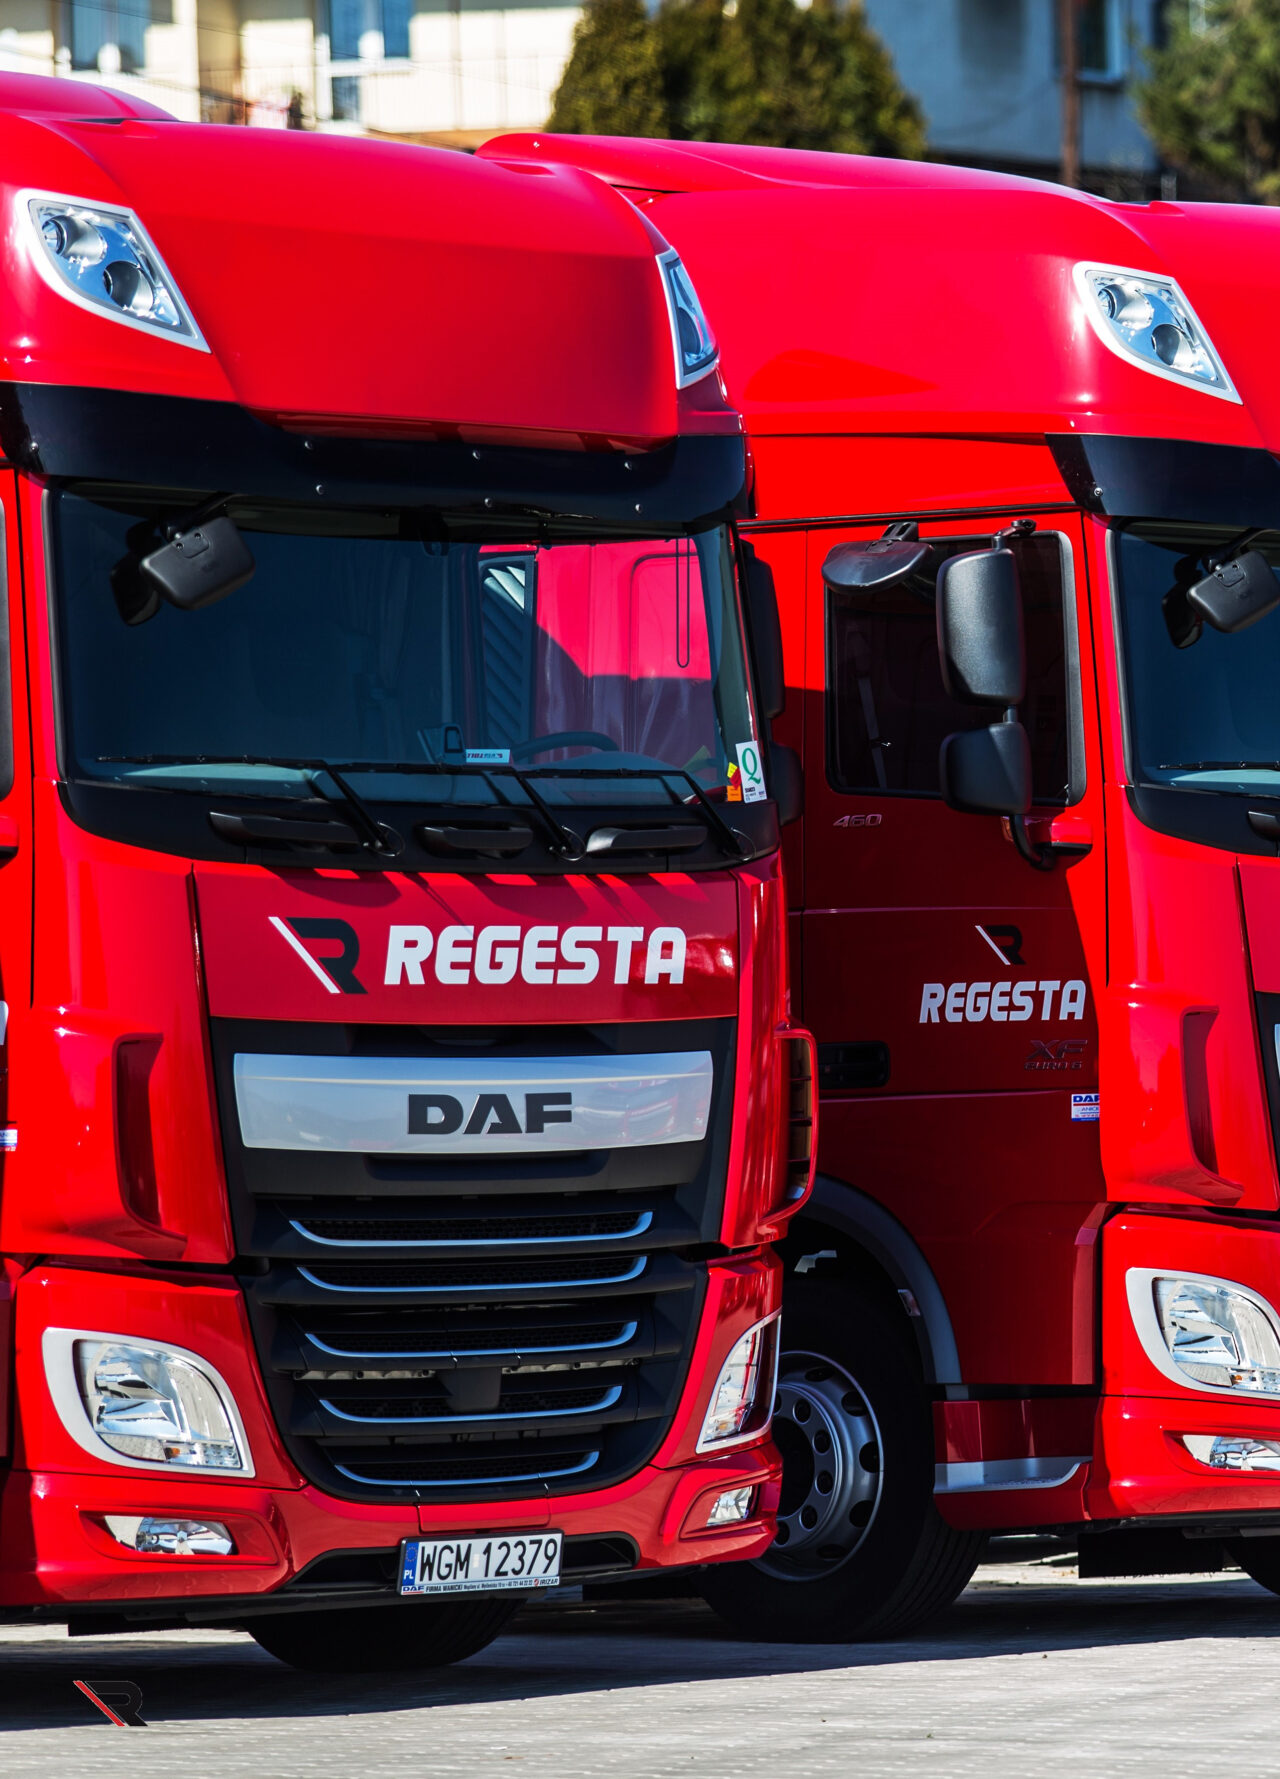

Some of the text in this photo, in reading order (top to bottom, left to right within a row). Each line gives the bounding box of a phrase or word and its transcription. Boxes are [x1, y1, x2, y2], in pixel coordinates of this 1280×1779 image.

[742, 747, 761, 785] Q
[833, 814, 882, 827] 460
[384, 924, 687, 985] REGESTA
[919, 979, 1087, 1024] REGESTA
[1027, 1039, 1088, 1059] XF
[407, 1092, 573, 1135] DAF
[403, 1569, 414, 1580] PL
[419, 1538, 559, 1582] WGM 12379
